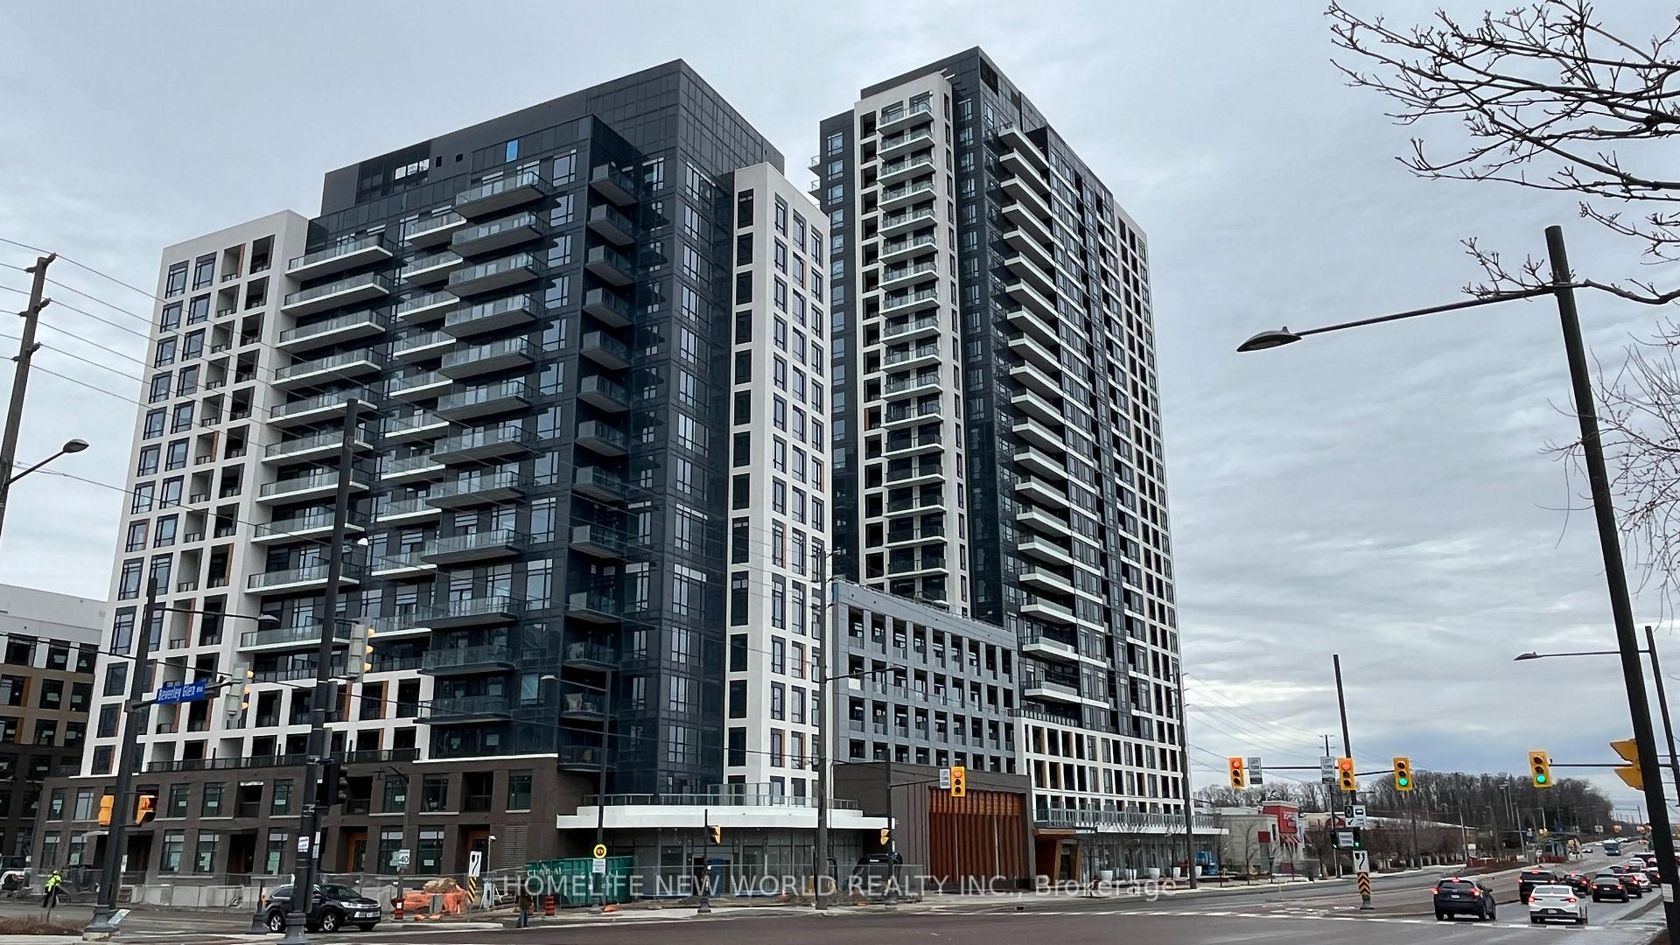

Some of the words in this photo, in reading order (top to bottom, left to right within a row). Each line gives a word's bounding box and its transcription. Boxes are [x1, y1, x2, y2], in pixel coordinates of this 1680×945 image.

[158, 686, 181, 701] Beverley
[182, 685, 195, 697] Glen
[399, 855, 409, 863] 40
